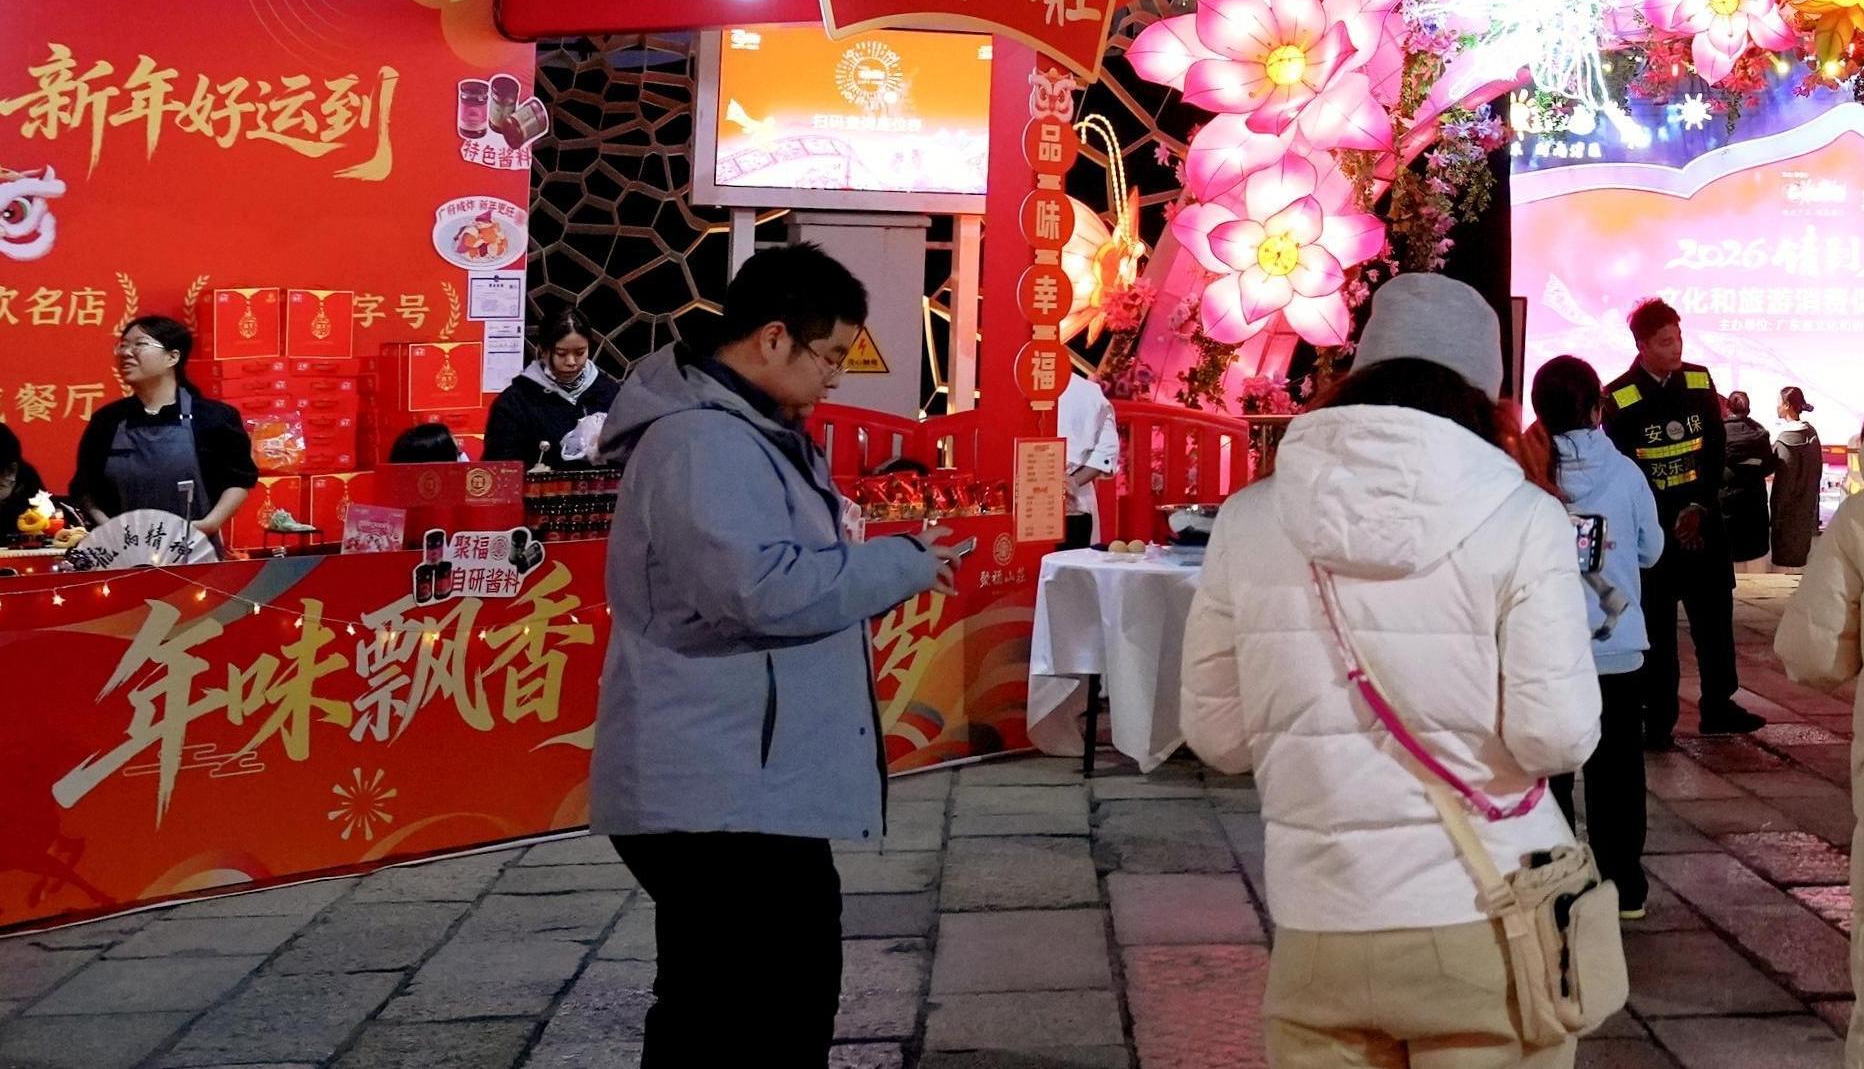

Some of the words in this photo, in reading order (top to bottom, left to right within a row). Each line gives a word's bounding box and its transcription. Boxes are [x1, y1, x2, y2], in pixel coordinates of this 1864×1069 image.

[0, 43, 399, 181] 新年好运到
[464, 140, 531, 167] 特色酱料
[1030, 124, 1062, 391] 品味幸福
[1664, 237, 1769, 272] 2026
[0, 382, 104, 422] 餐厅
[1645, 424, 1662, 443] 安
[1687, 415, 1702, 434] 保
[453, 535, 489, 560] 聚福
[451, 568, 520, 594] 自研酱料
[52, 561, 595, 829] 年味飘香
